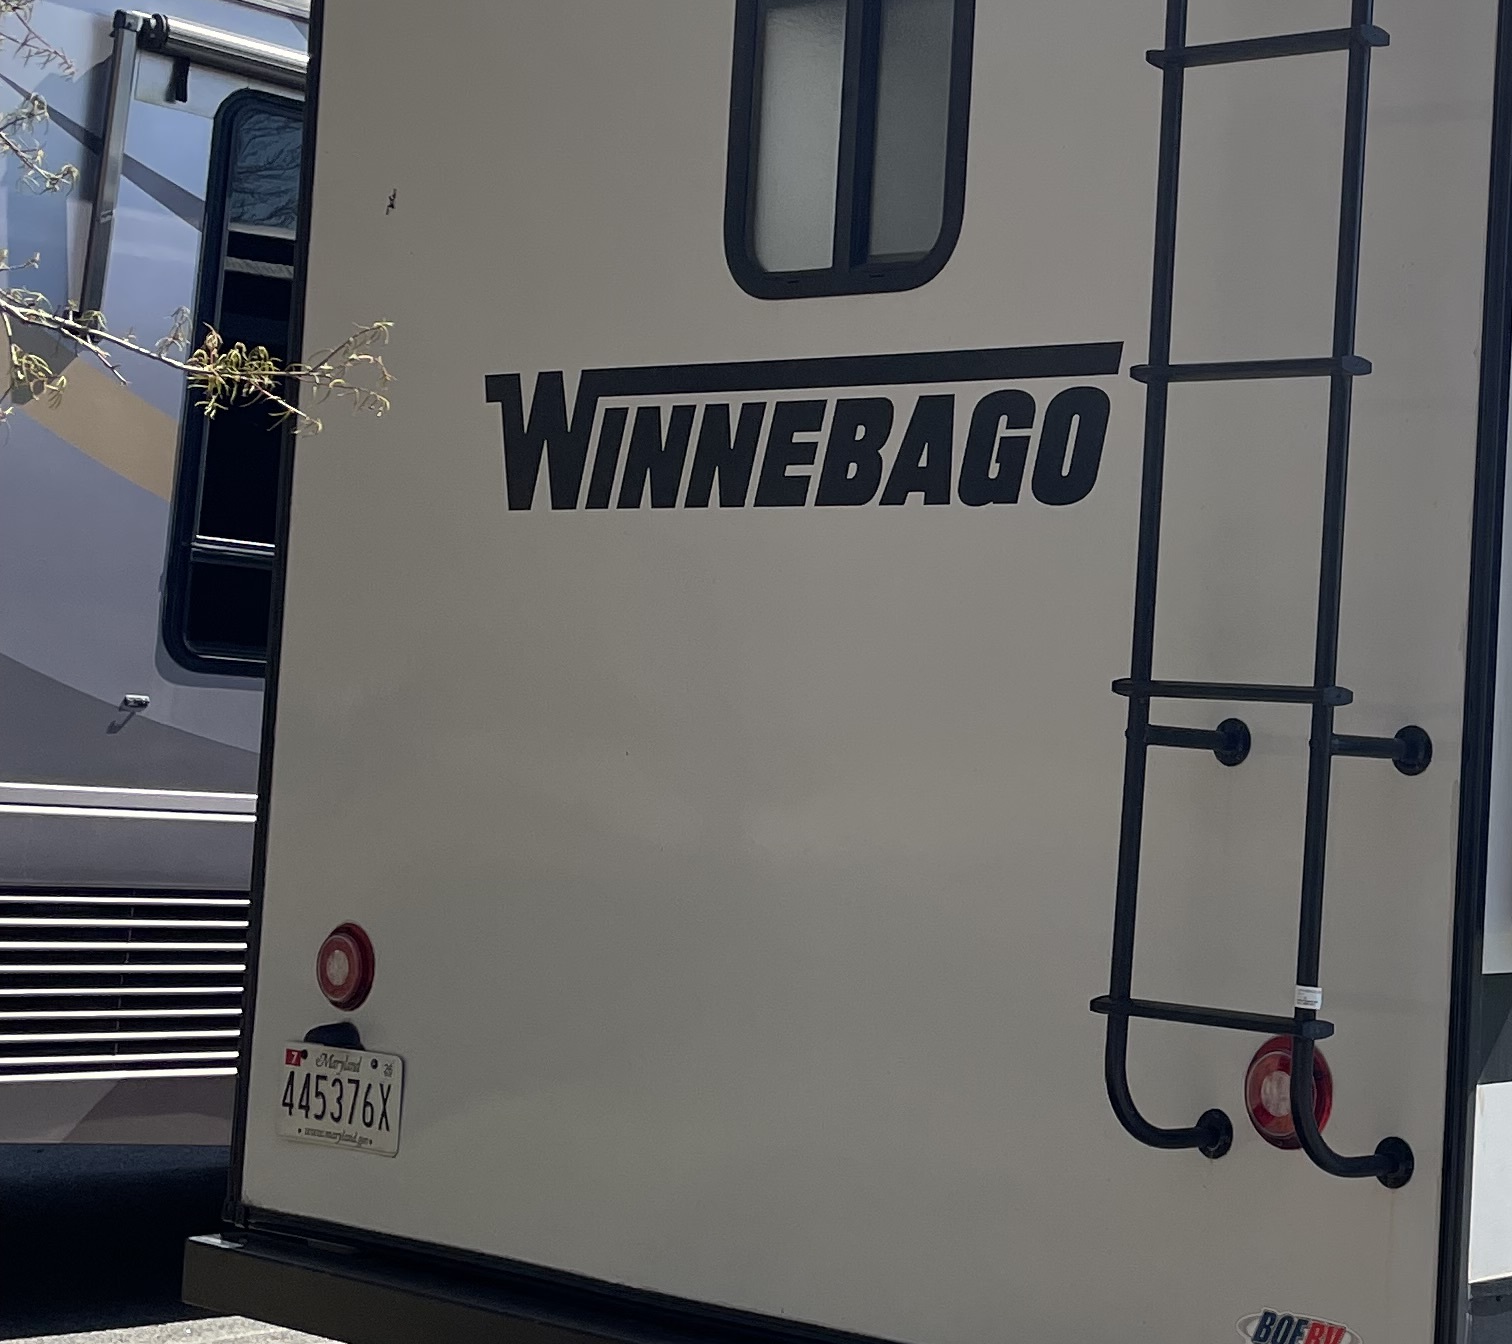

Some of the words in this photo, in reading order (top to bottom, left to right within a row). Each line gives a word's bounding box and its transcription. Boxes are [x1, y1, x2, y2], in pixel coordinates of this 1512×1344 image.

[485, 341, 1124, 511] WINNEBAGO
[315, 1053, 362, 1076] Maryland
[281, 1070, 392, 1132] 445376X
